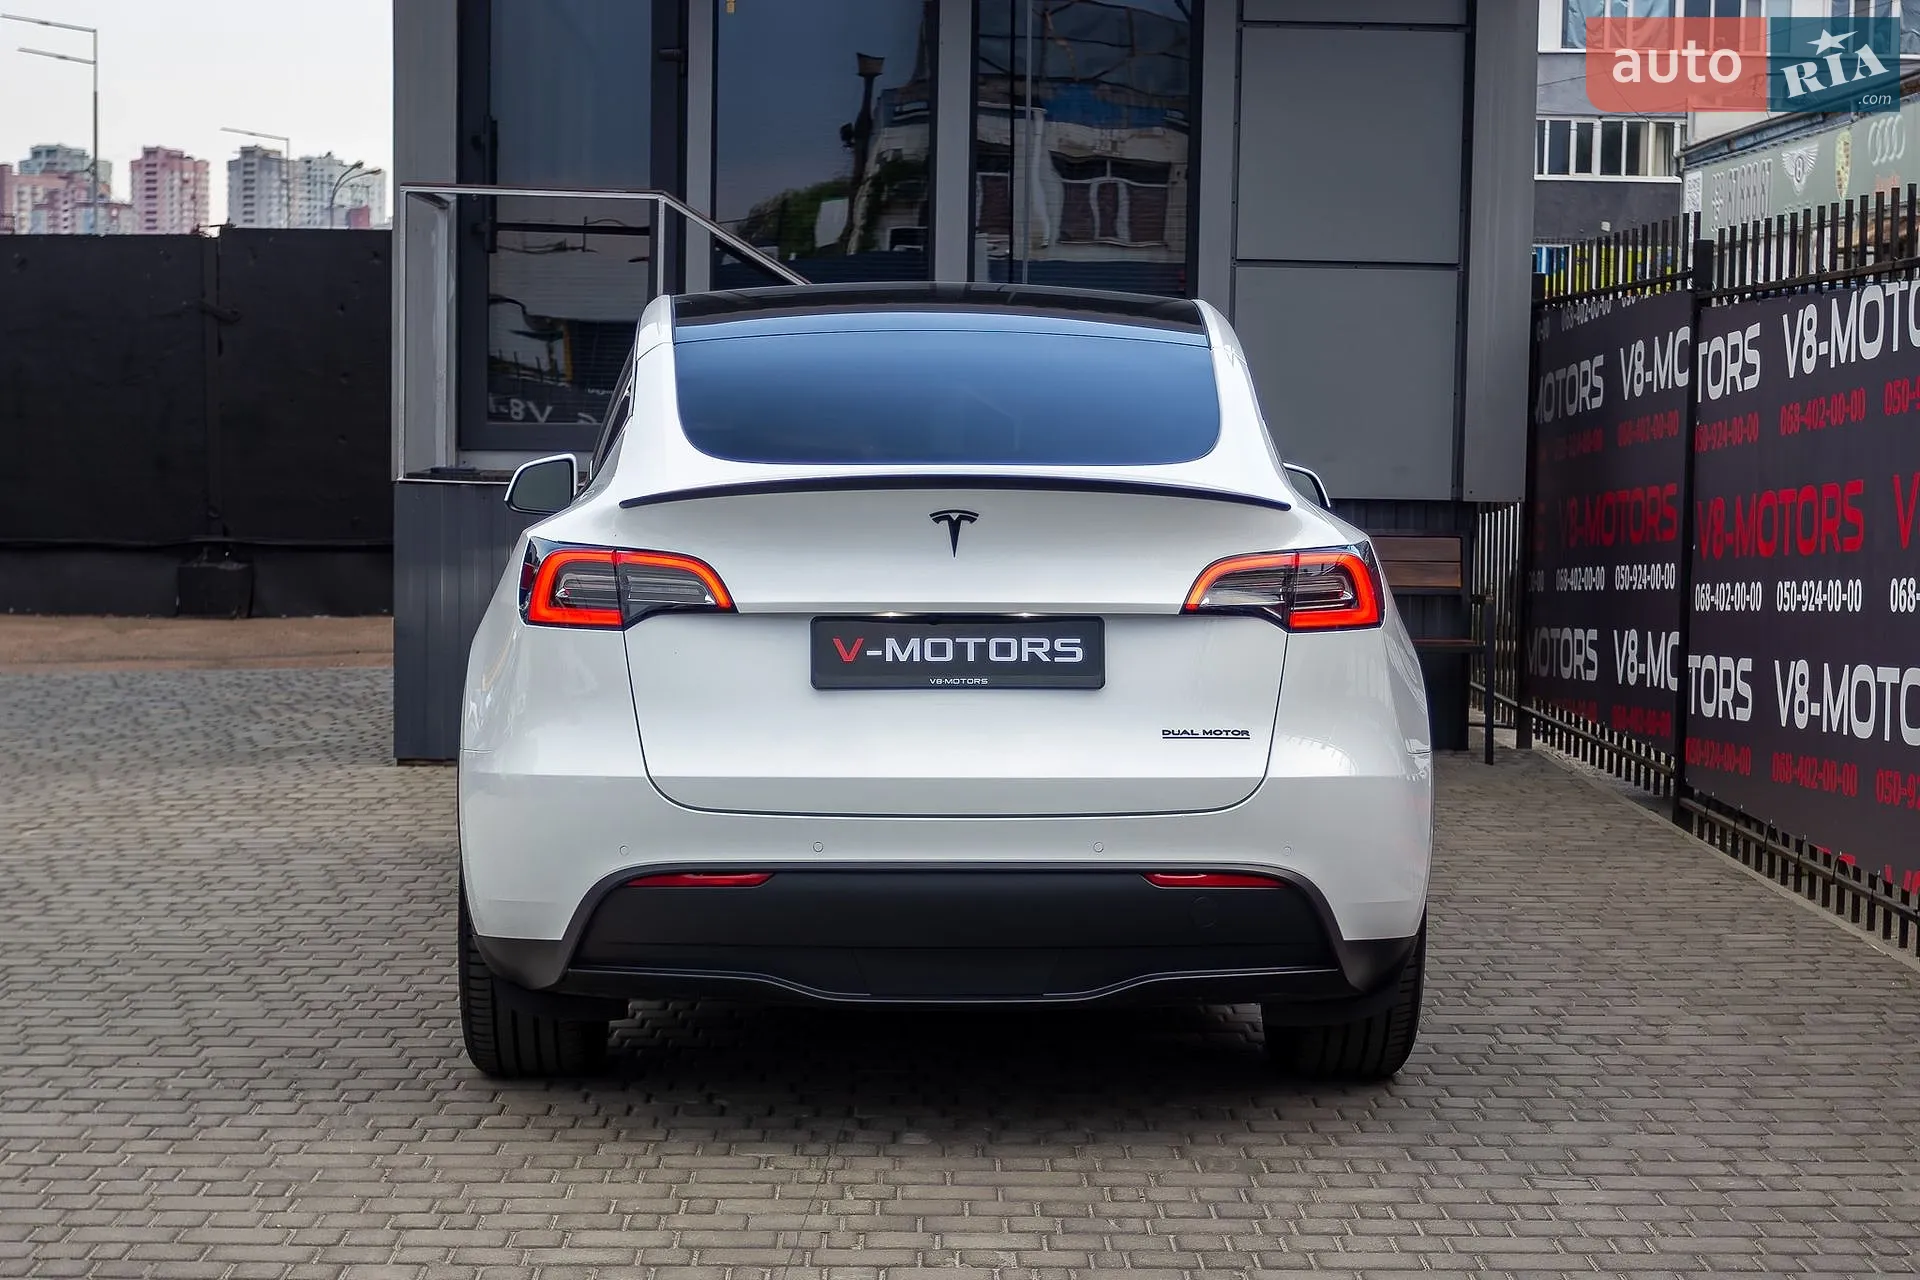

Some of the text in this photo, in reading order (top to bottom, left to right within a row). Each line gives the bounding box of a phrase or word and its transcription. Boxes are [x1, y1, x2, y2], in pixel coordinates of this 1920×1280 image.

[1780, 387, 1866, 436] 068-402-00-00
[1561, 484, 1677, 548] V8-MOTORS
[1698, 470, 1920, 560] V8-MOTORS V
[1555, 565, 1605, 592] 068-402-00-00
[1615, 562, 1676, 591] 050-924-00-00
[1695, 582, 1763, 612] 068-402-00-00
[1776, 578, 1863, 613] 050-924-00-00
[832, 637, 1083, 663] V-MOTORS
[929, 677, 988, 685] V8-MOTORS
[1688, 654, 1752, 722] TORS
[1772, 751, 1858, 798] 068-402-00-00
